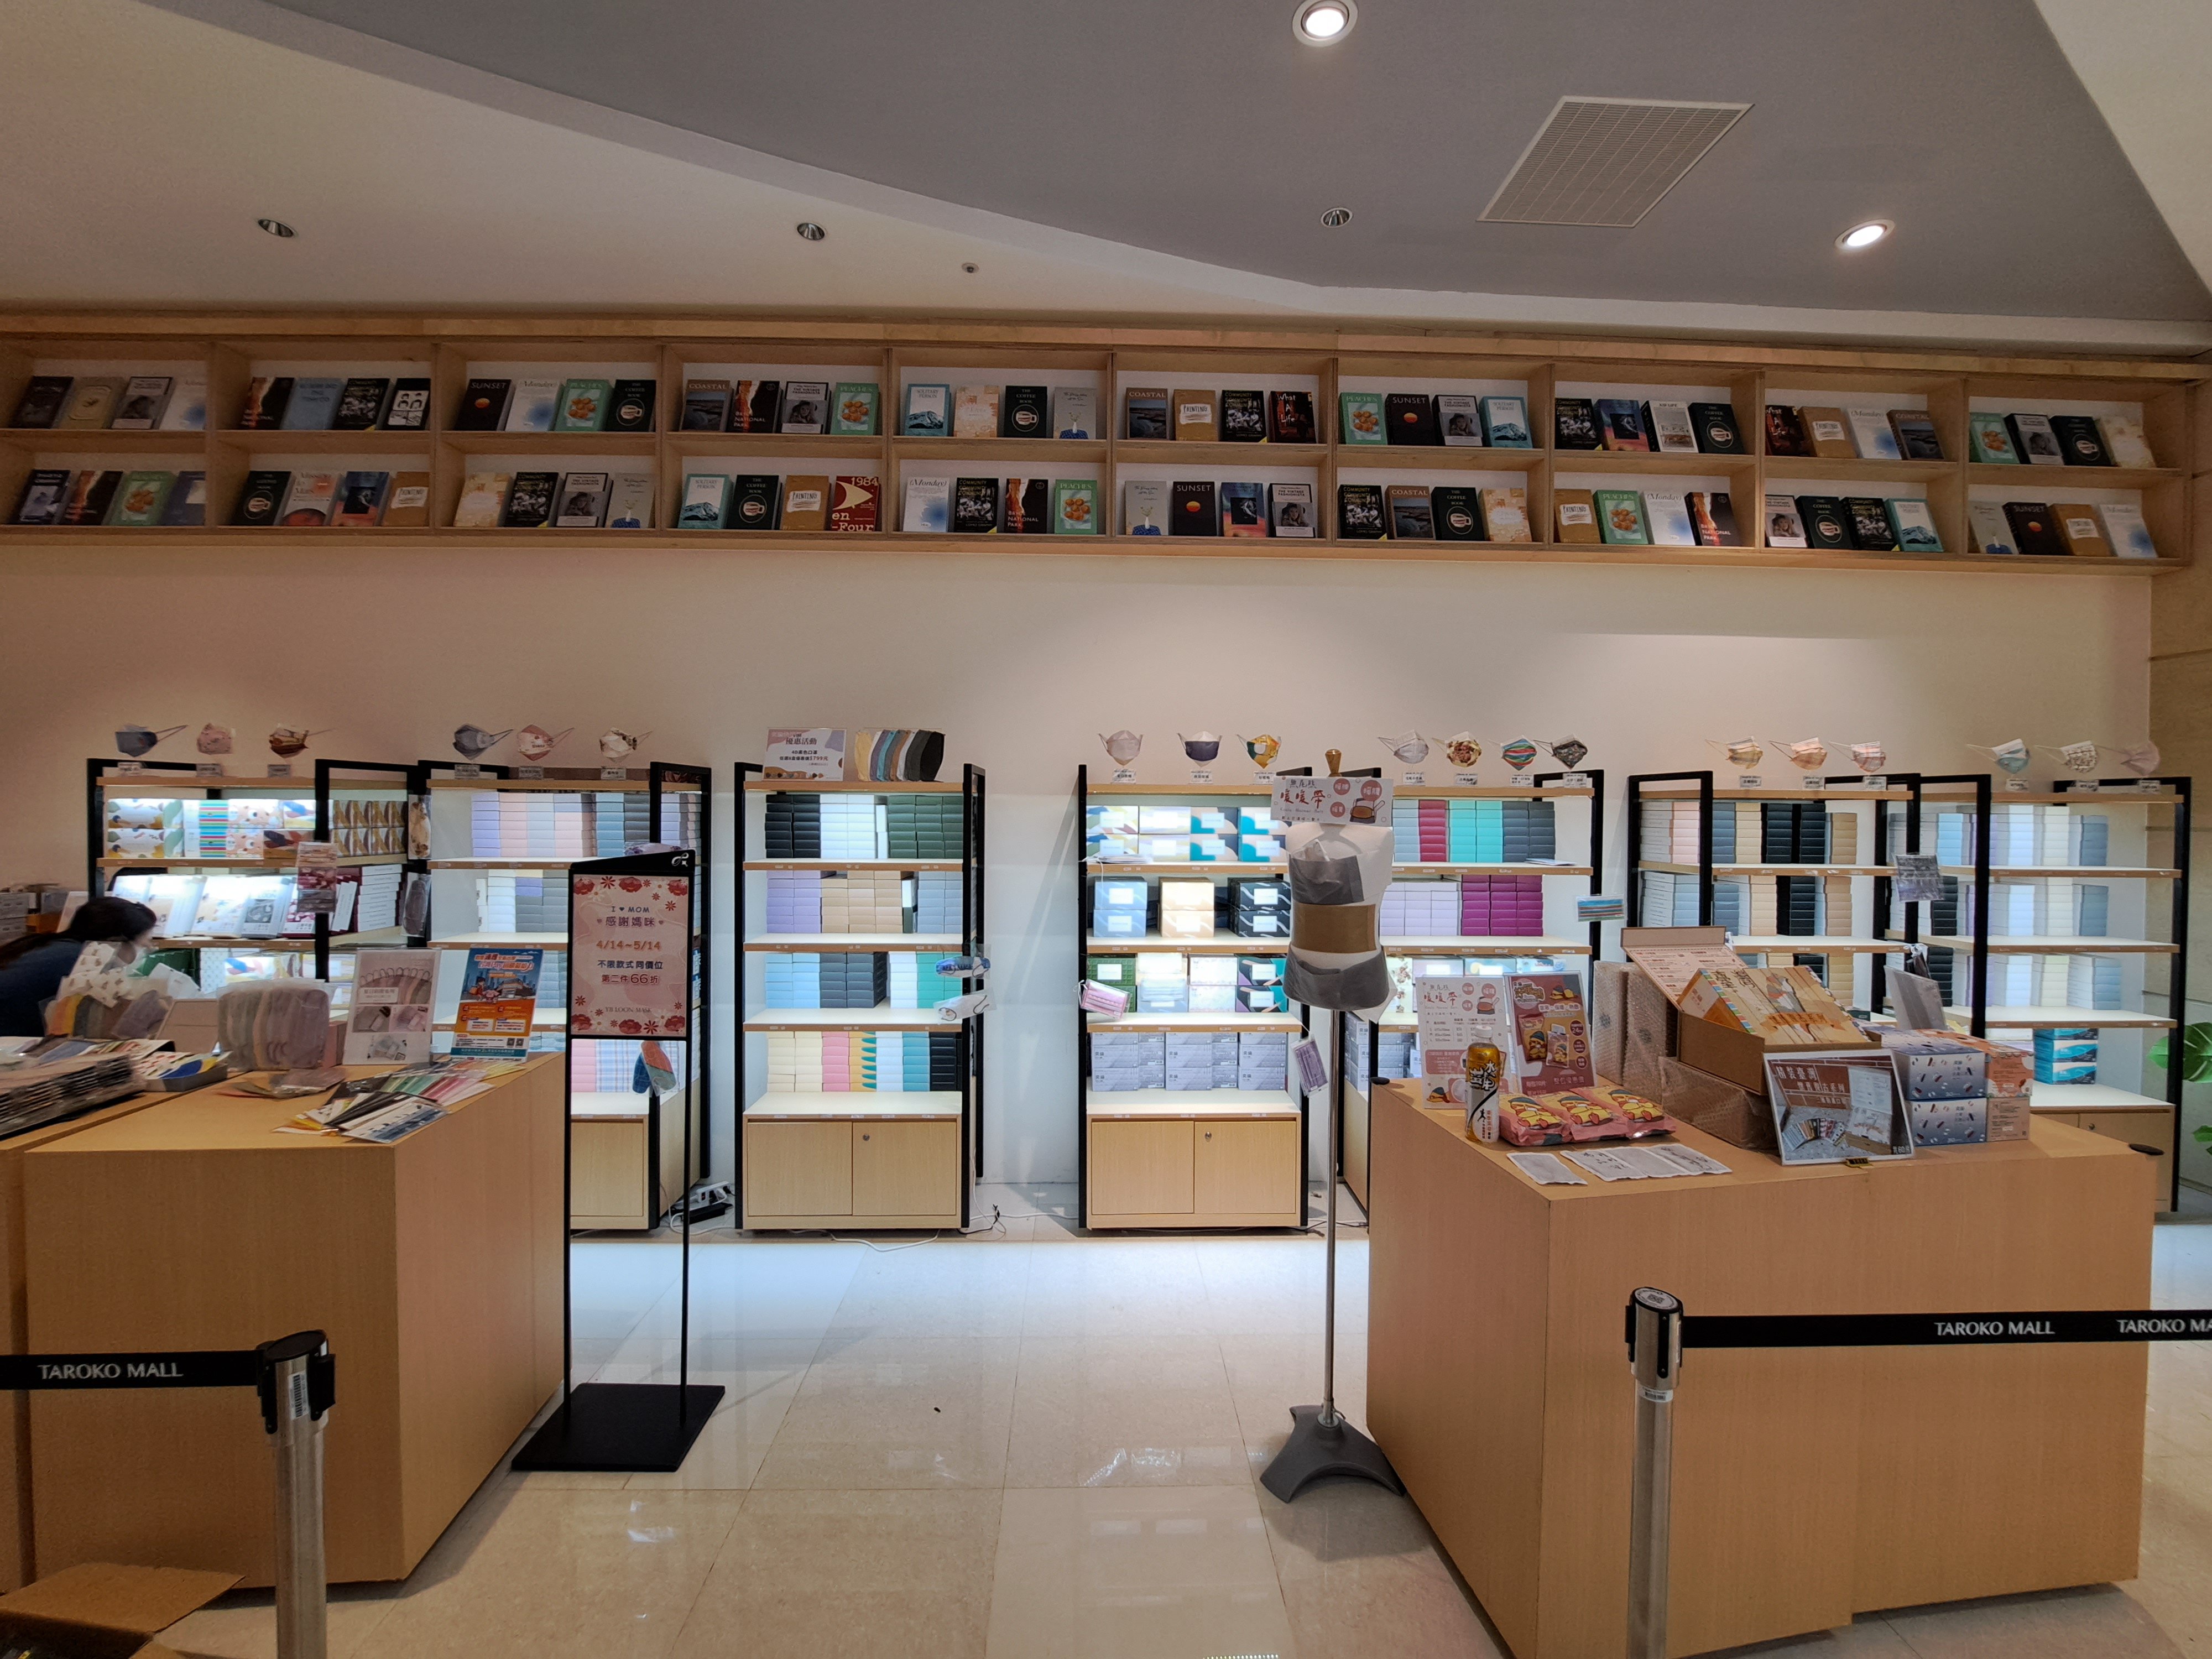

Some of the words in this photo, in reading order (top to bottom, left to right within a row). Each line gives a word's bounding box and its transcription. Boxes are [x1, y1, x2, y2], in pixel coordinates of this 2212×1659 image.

[1183, 405, 1208, 413] PAINTING
[1281, 415, 1296, 424] Life
[851, 477, 878, 486] 1984
[792, 492, 818, 500] PAINTING
[1563, 505, 1587, 513] PAINTING
[832, 512, 851, 520] en
[1280, 789, 1326, 808] 暖暖帶
[606, 917, 655, 927] 感謝媽咪
[596, 940, 662, 950] 4/14~5/14
[602, 974, 659, 984] 第二件66折
[1934, 1322, 2004, 1336] TAROKO
[2008, 1321, 2056, 1335] MALL
[2115, 1319, 2185, 1333] TAROKO
[37, 1364, 121, 1380] TAROKO
[127, 1362, 184, 1378] MALL
